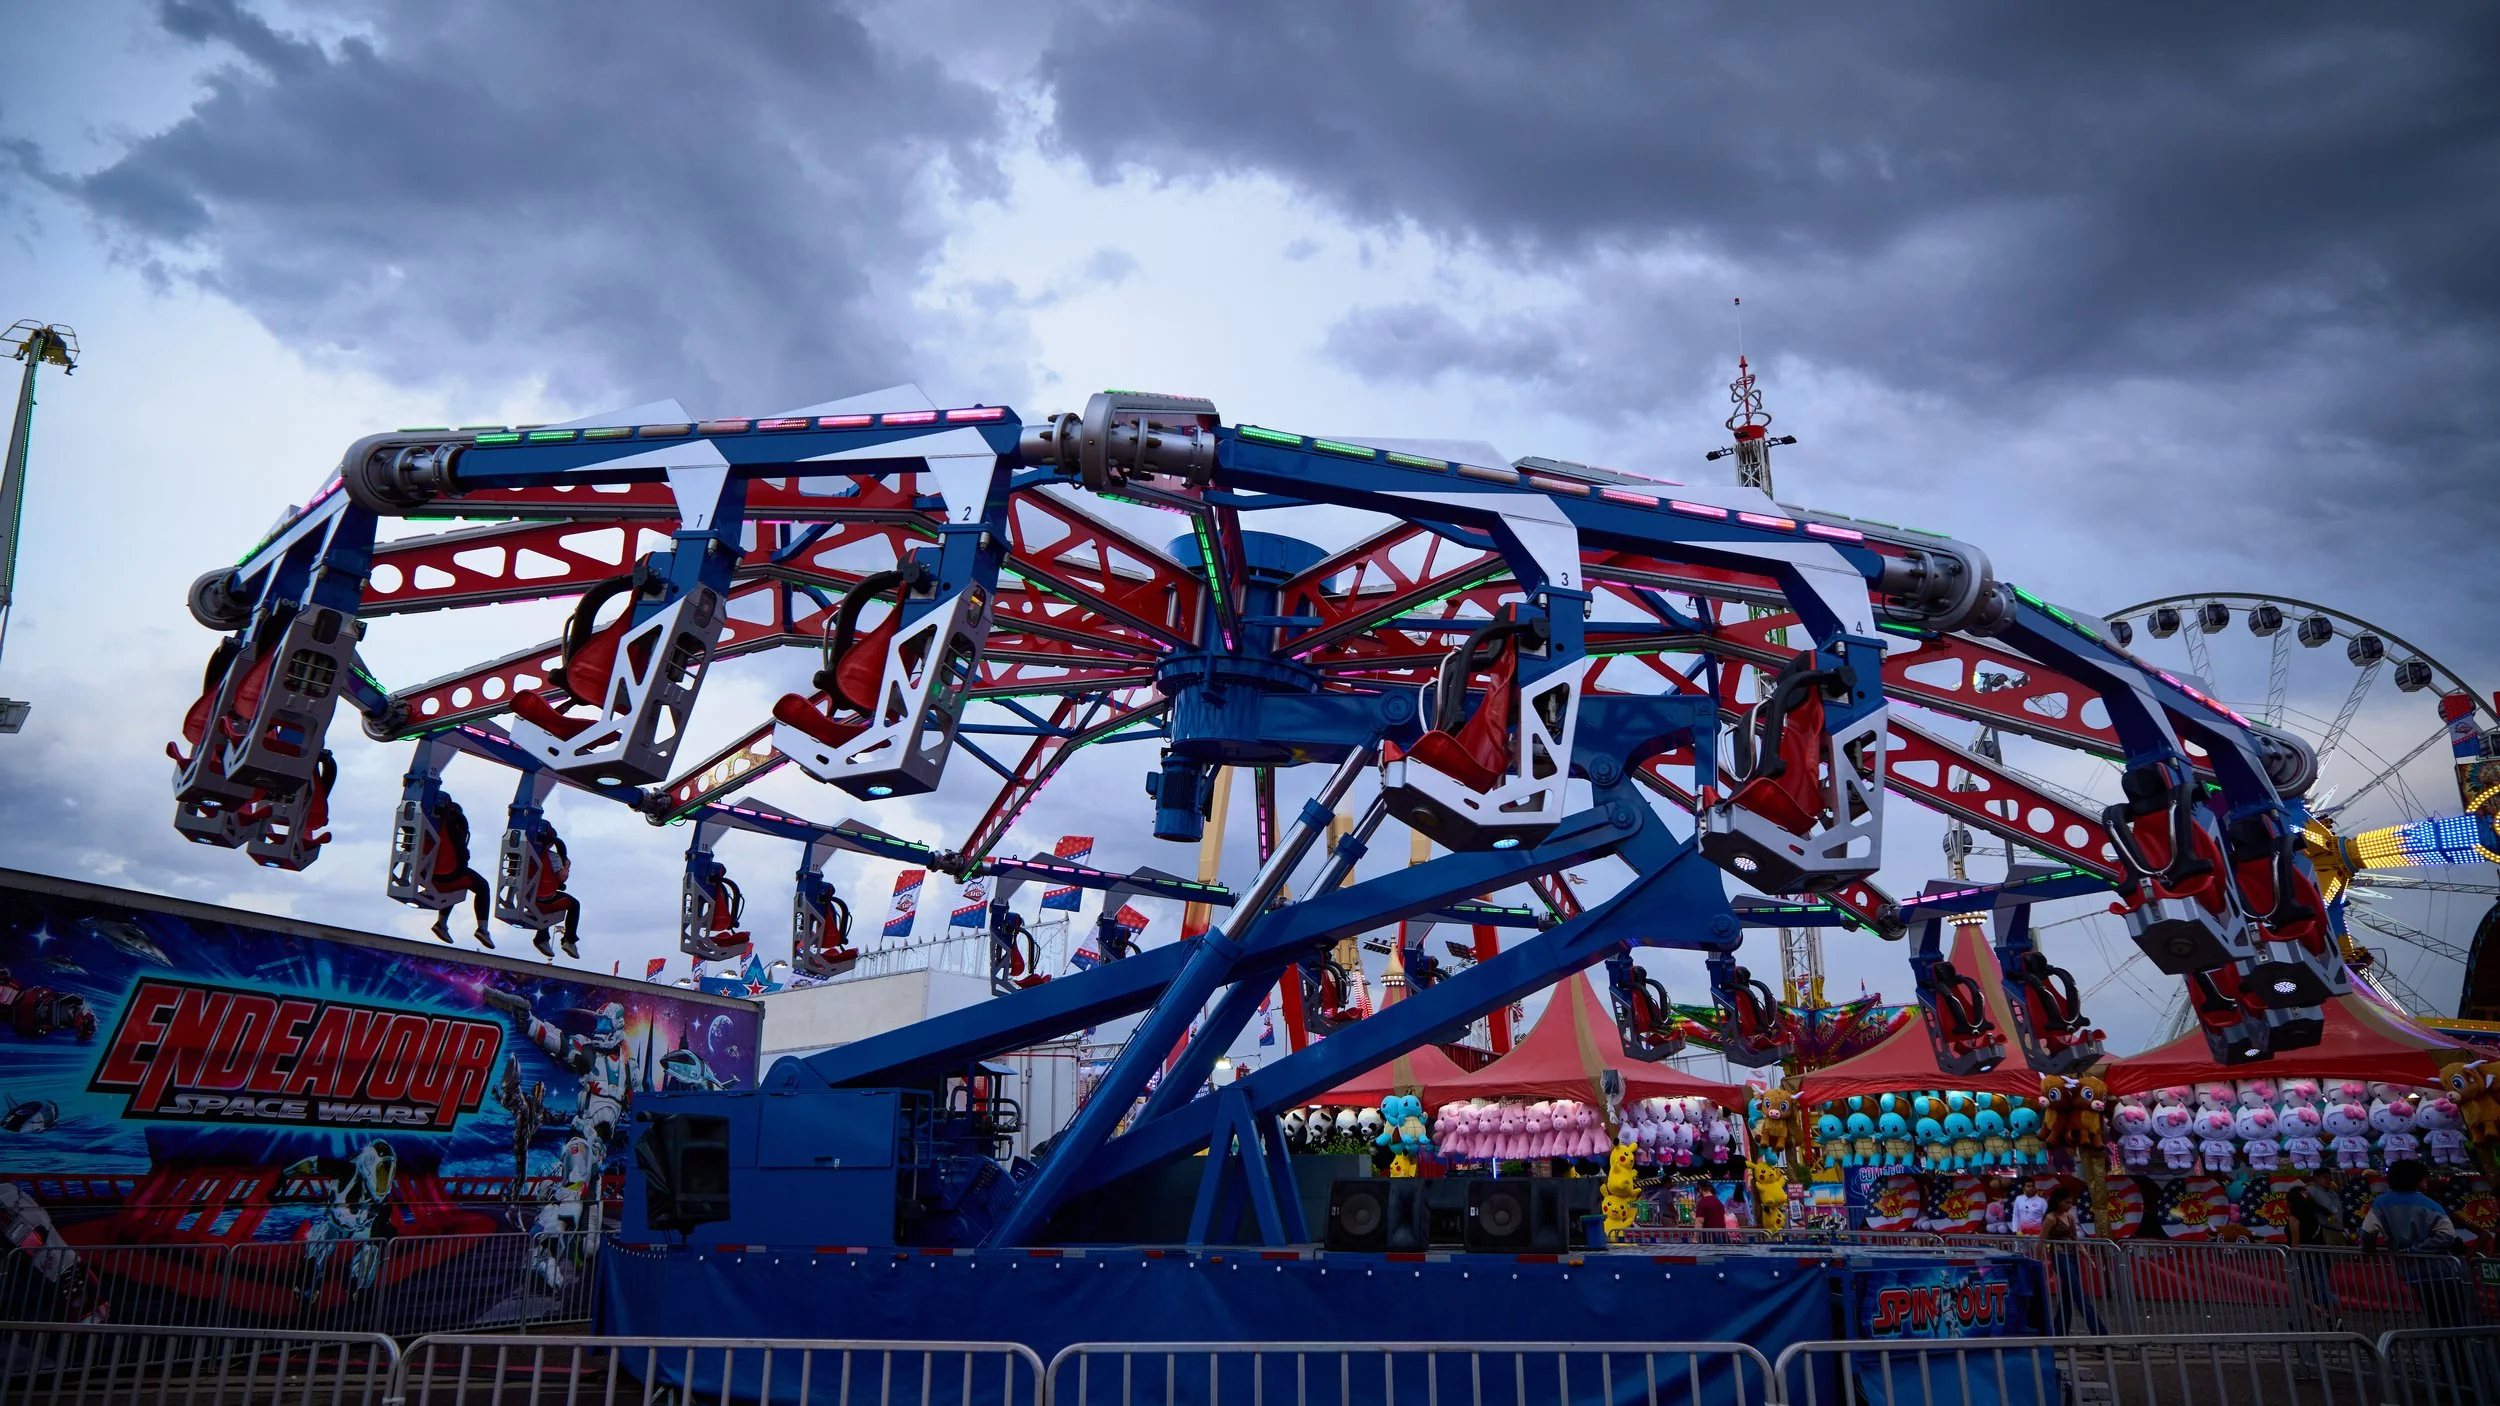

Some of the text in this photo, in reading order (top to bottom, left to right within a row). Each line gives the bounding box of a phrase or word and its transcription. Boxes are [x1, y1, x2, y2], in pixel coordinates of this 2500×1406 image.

[962, 506, 972, 521] 2
[696, 514, 704, 528] 1
[1561, 572, 1569, 586] 3
[1855, 620, 1864, 635] 4
[96, 982, 502, 1126] ENDEAVOUR
[158, 1093, 441, 1125] SPACE WARS
[1886, 1198, 1896, 1208] A
[1952, 1199, 1962, 1209] A
[1882, 1208, 1903, 1217] BALL
[1948, 1209, 1968, 1218] BALL
[2187, 1204, 2199, 1214] A
[2272, 1204, 2286, 1215] A
[2476, 1204, 2491, 1216] A
[2183, 1215, 2207, 1224] BALL
[2269, 1217, 2289, 1226] BAL
[1873, 1283, 2008, 1331] SPIN OUT
